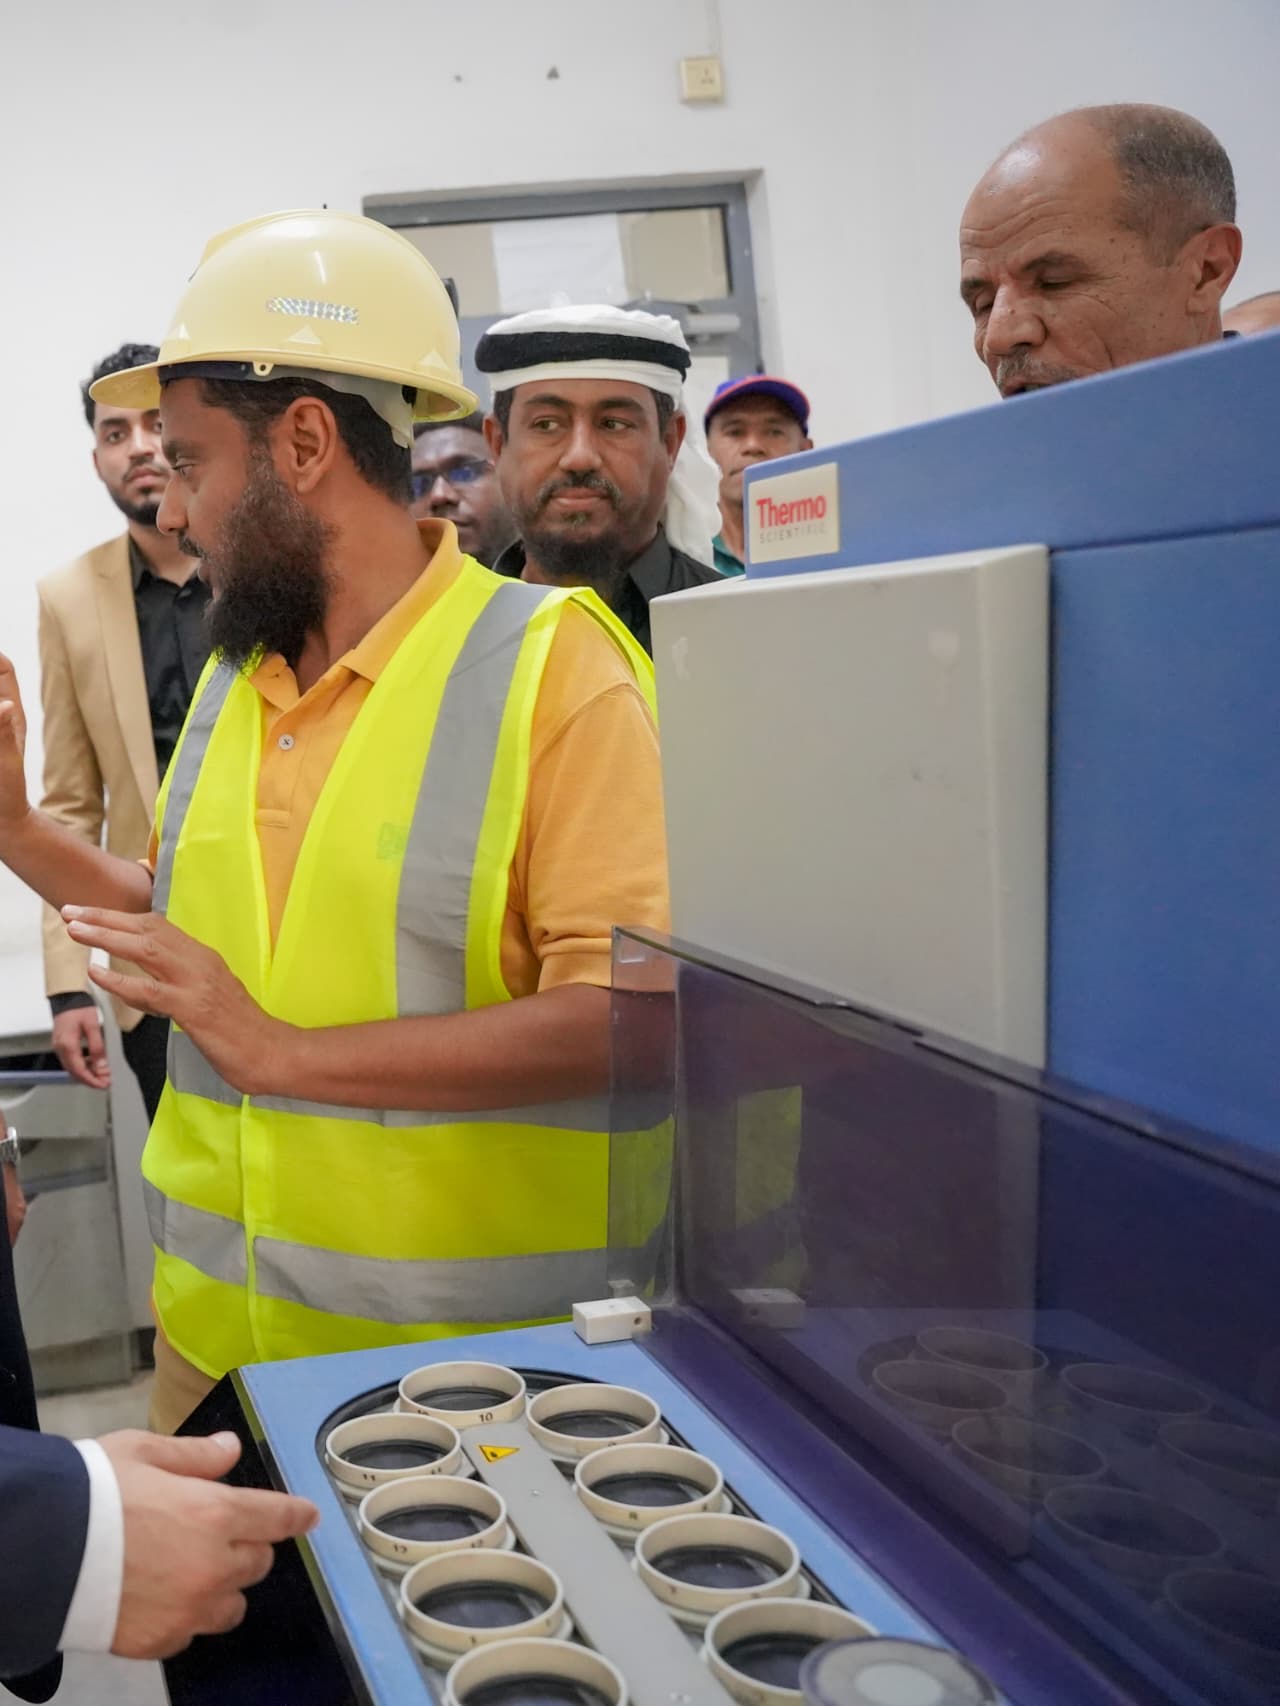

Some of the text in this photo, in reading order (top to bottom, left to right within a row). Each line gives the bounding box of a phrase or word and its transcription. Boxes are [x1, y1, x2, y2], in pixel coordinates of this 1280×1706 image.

[756, 495, 827, 528] Thermo
[760, 523, 827, 544] SCIENTIFIC
[480, 1412, 493, 1422] 10
